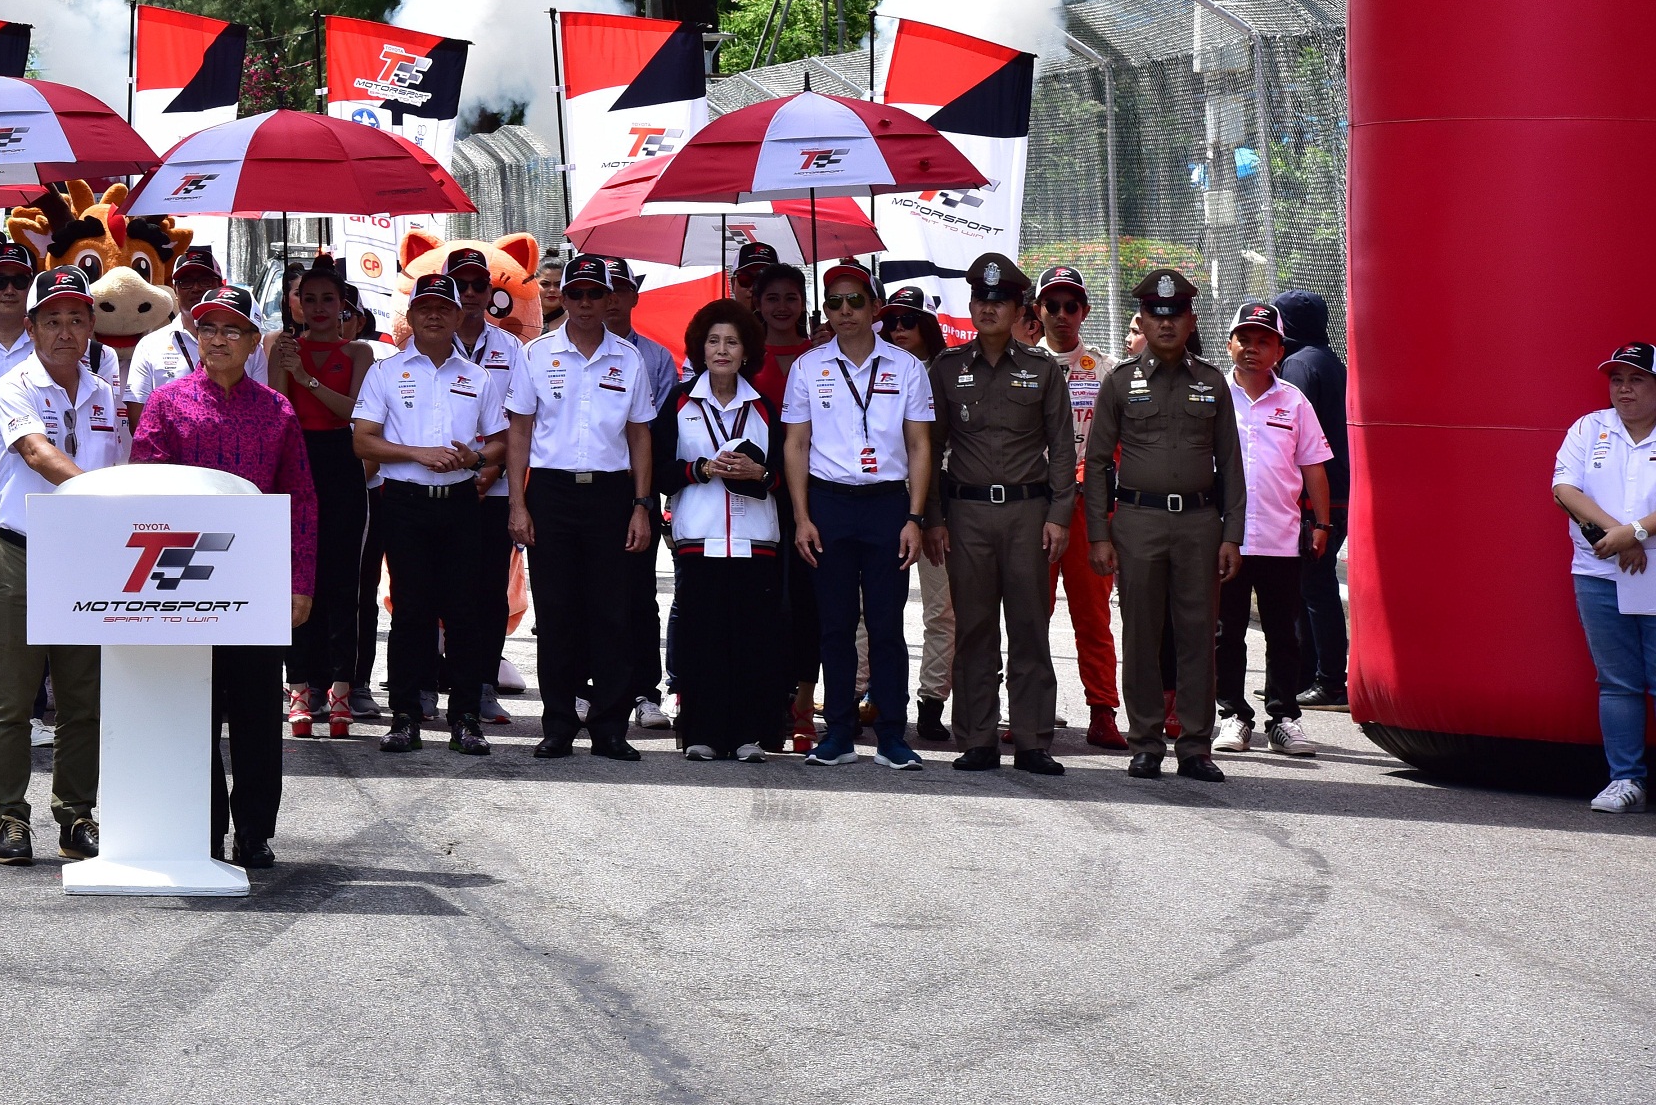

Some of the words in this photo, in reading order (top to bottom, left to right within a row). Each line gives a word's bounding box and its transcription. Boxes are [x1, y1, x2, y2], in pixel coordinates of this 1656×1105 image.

[891, 197, 1004, 236] MOTORSPORT
[363, 258, 380, 271] CP
[132, 523, 171, 531] TOYOTA
[72, 601, 249, 612] MOTORSPORT
